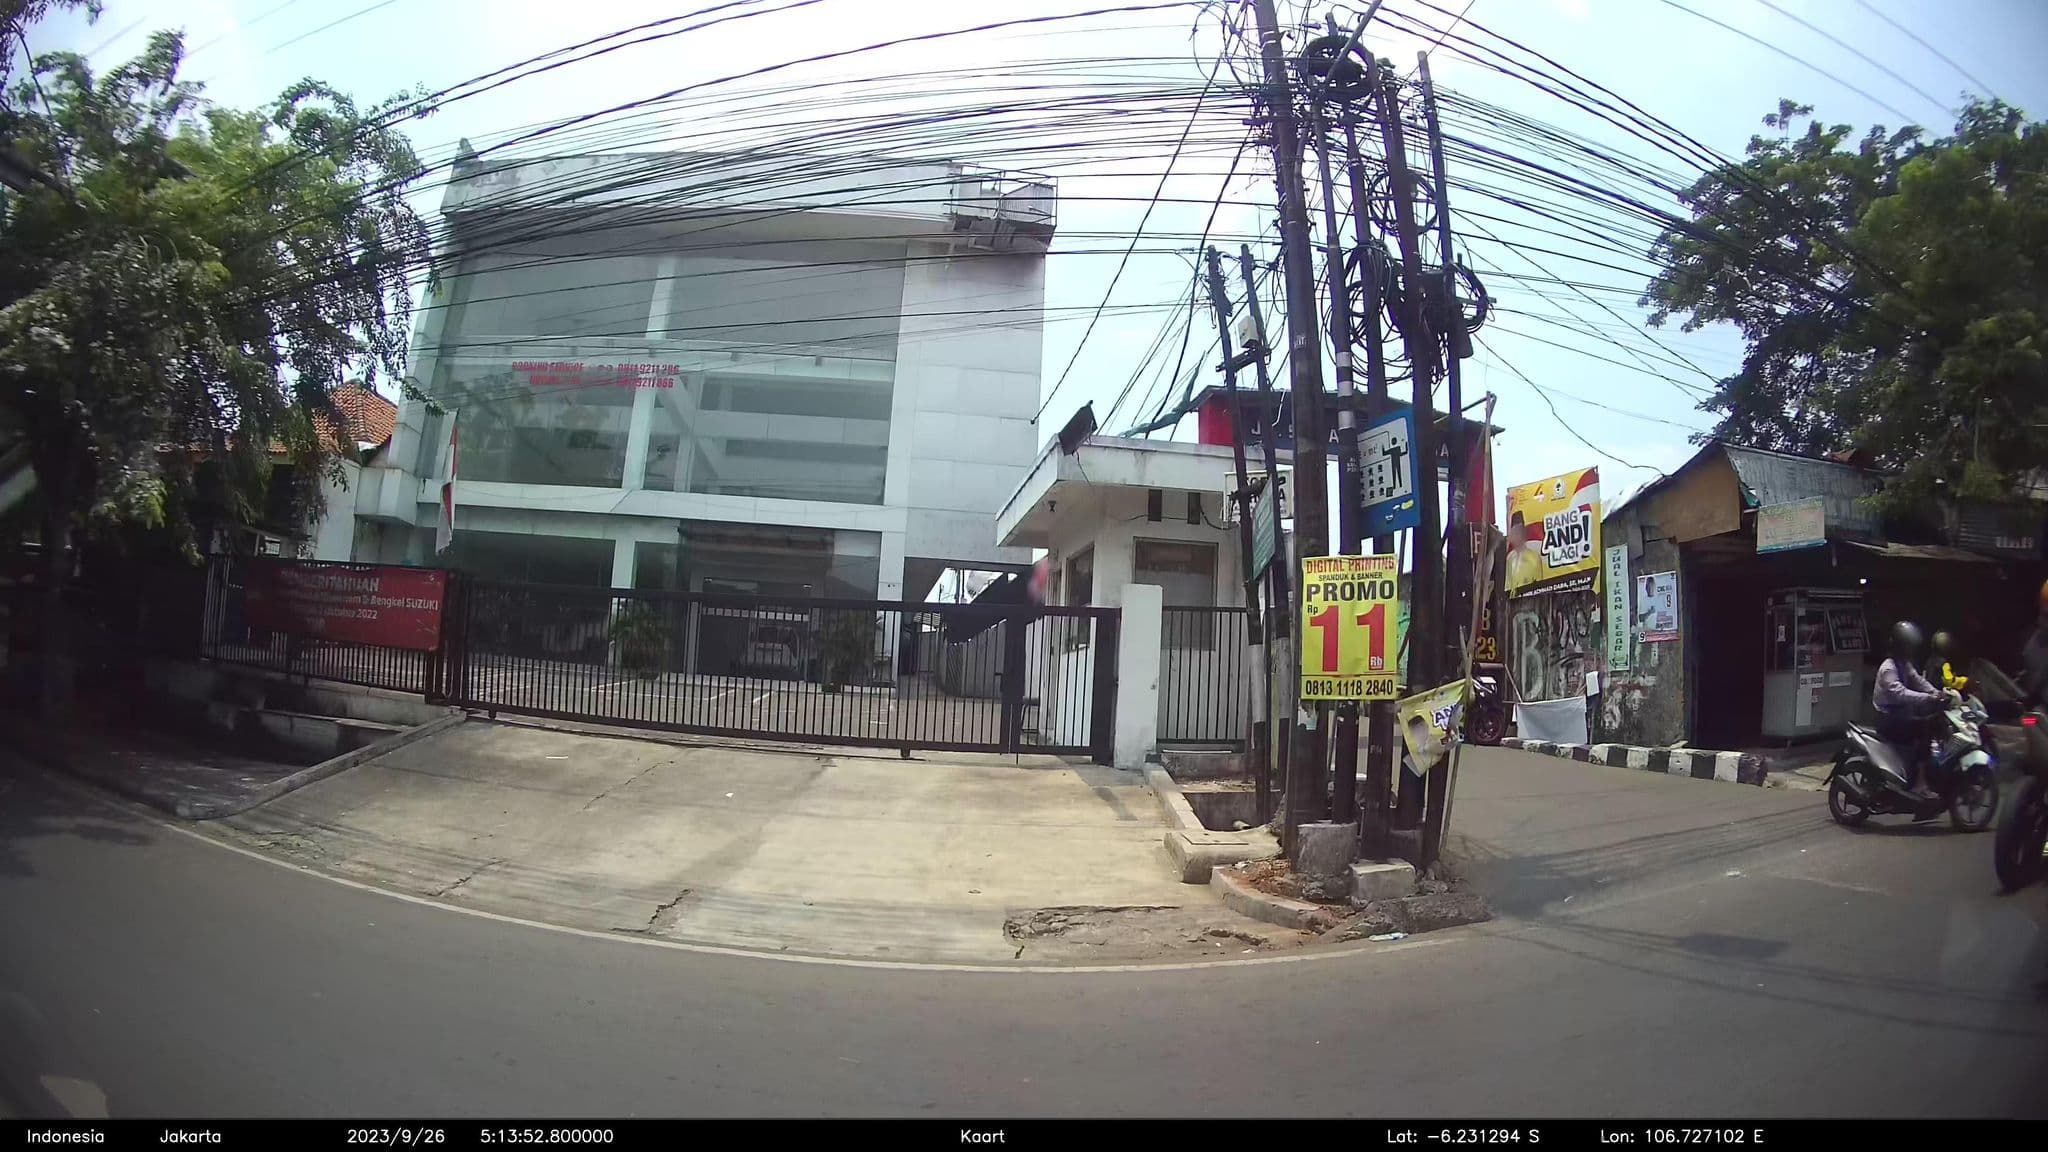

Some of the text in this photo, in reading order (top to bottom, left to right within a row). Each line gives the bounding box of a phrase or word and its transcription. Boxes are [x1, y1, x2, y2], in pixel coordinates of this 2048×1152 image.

[1546, 511, 1578, 529] BANG
[1552, 545, 1579, 561] LAGI
[1306, 556, 1395, 574] DIGITAL PRINTING
[1318, 571, 1383, 581] SPANDUK & BANNER
[1306, 580, 1395, 602] PROMO
[406, 597, 439, 611] SUZUKI
[1307, 604, 1318, 615] Rp
[356, 608, 378, 620] 2022
[1305, 679, 1393, 696] 0813 1118 2840
